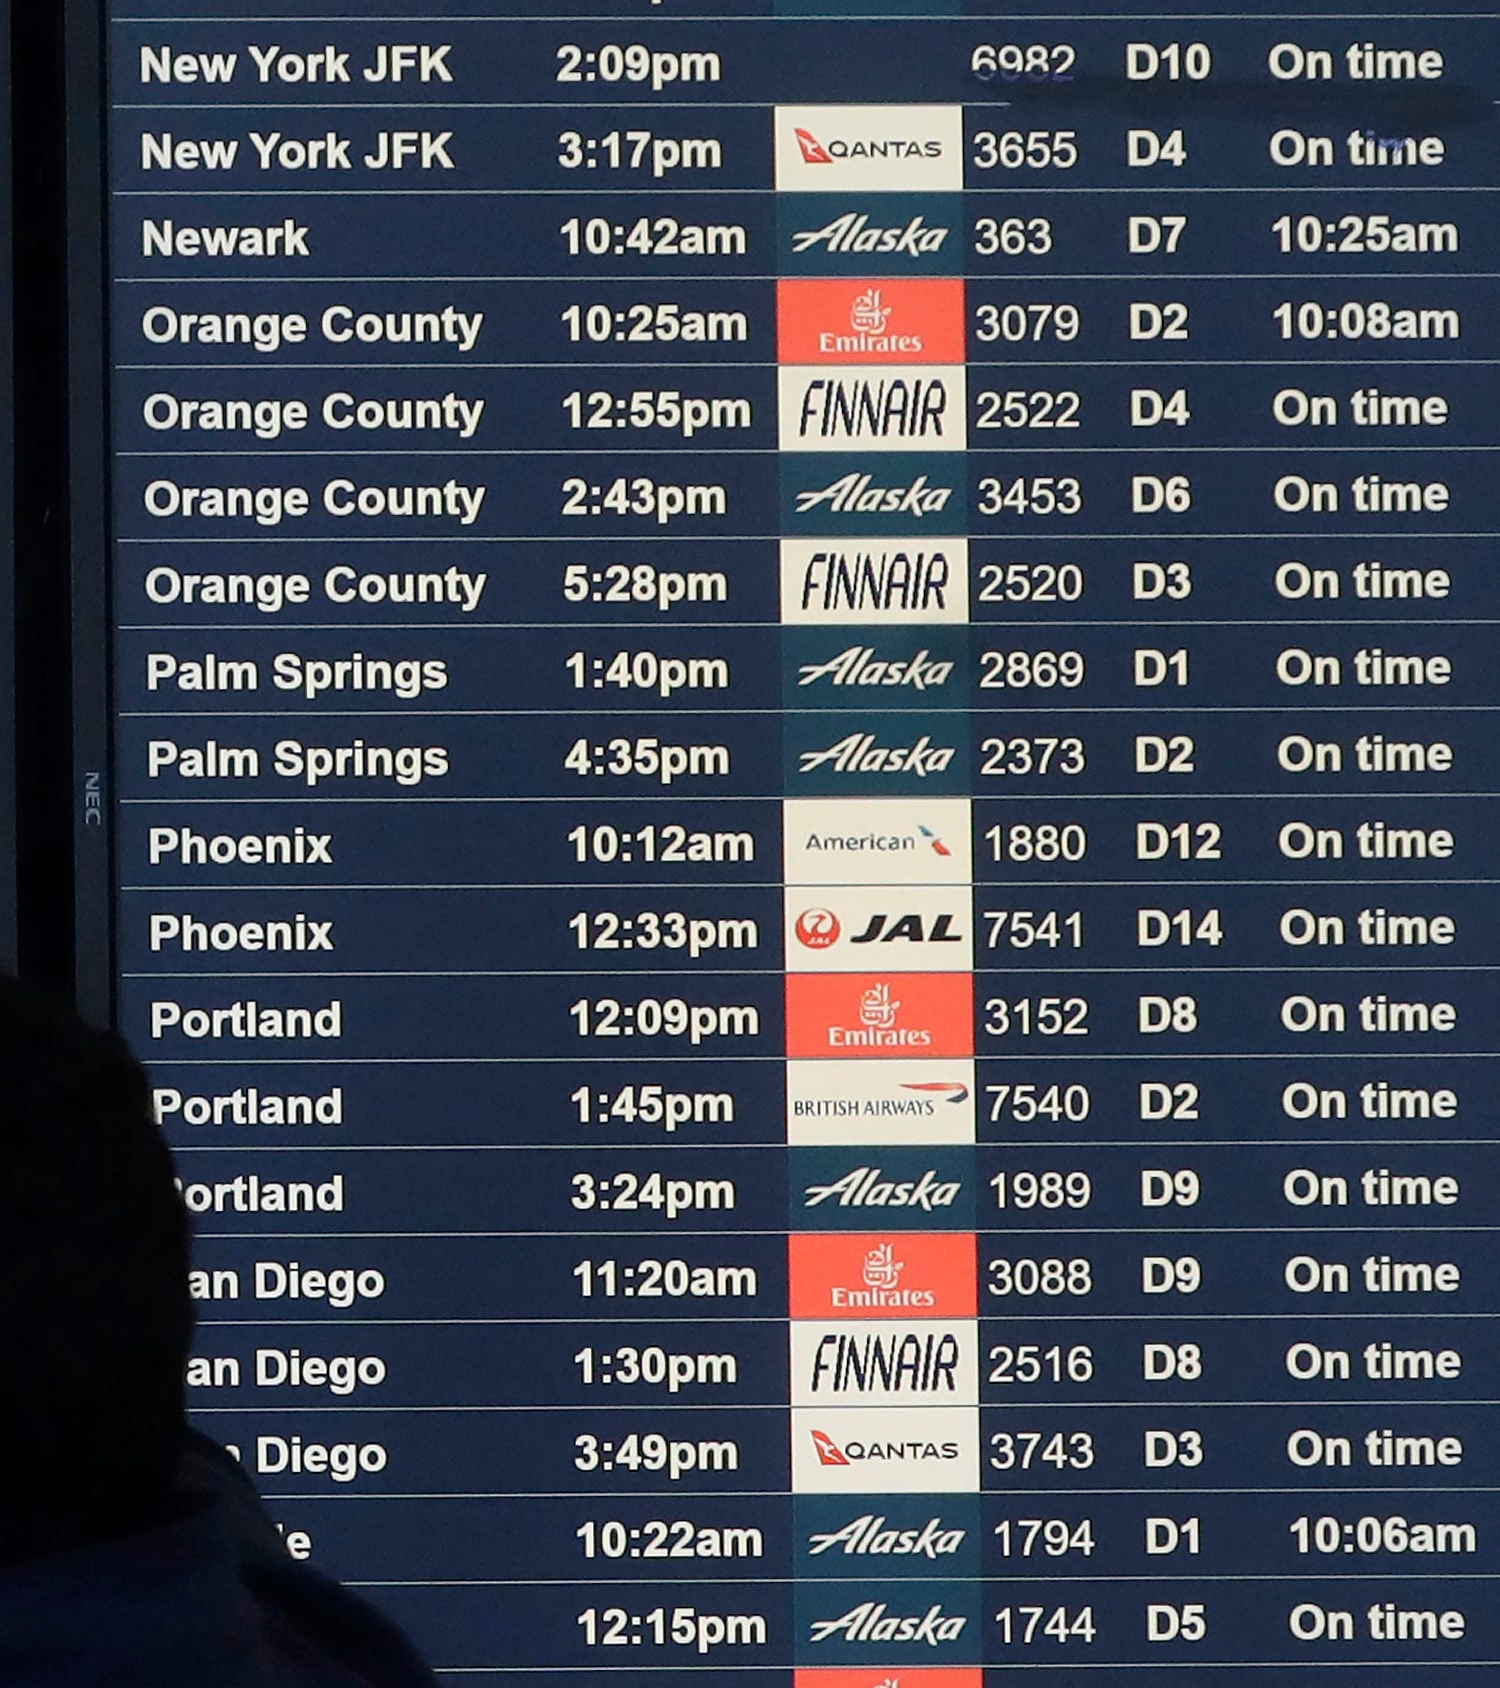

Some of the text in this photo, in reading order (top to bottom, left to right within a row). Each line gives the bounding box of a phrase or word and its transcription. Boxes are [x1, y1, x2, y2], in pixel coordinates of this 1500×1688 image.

[140, 45, 453, 83] New York JFK
[556, 44, 720, 91] 2:09pm
[971, 44, 1076, 81] 6982
[1126, 43, 1211, 80] D10
[1268, 42, 1443, 80] On time
[142, 131, 455, 170] New York JFK
[558, 131, 721, 178] 3:17pm
[829, 140, 942, 158] QANTAS
[143, 219, 310, 257] Newark
[560, 217, 746, 255] 10:42am
[792, 212, 948, 257] Alaska
[975, 218, 1052, 255] 363
[1272, 215, 1458, 253] 10:25am
[561, 304, 747, 342] 10:25am
[1130, 302, 1188, 340] D2
[1273, 301, 1459, 339] 10:08am
[819, 332, 922, 352] Emirates
[143, 392, 485, 439] Orange County
[800, 379, 947, 437] FINNAIR
[976, 391, 1080, 428] 2522
[561, 478, 726, 524] 2:43pm
[795, 472, 952, 518] Alaska
[1132, 475, 1191, 513] D6
[145, 566, 487, 613] Orange County
[802, 552, 949, 610] FINNAIR
[978, 564, 1083, 601] 2520
[147, 652, 448, 699] Palm Springs
[566, 651, 728, 698] 1:40pm
[798, 646, 955, 690] Alaska
[1134, 649, 1188, 686] D1
[148, 739, 449, 786] Palm Springs
[799, 733, 955, 777] Alaska
[980, 737, 1085, 775] 2373
[85, 772, 101, 825] NEC
[149, 826, 333, 864] Phoenix
[568, 825, 754, 862] 10:12am
[805, 833, 915, 851] American
[1278, 821, 1454, 859] On time
[150, 913, 334, 951] Phoenix
[850, 914, 962, 944] JAL
[983, 911, 1081, 948] 7541
[151, 1000, 341, 1038] Portland
[570, 998, 759, 1045] 12:09pm
[1139, 996, 1197, 1033] D8
[828, 1027, 931, 1047] Emirates
[152, 1087, 342, 1125] Portland
[794, 1100, 934, 1116] BRITISH AIRWAYS
[985, 1084, 1090, 1122] 7540
[174, 1174, 343, 1212] ortland
[571, 1172, 734, 1219] 3:24pm
[804, 1167, 962, 1212] Alaska
[1141, 1169, 1200, 1206] D9
[188, 1262, 385, 1308] an Diego
[988, 1258, 1092, 1296] 3088
[831, 1287, 936, 1308] Emirates
[811, 1334, 959, 1392] FINNAIR
[1143, 1343, 1202, 1380] D8
[257, 1436, 387, 1482] Diego
[574, 1434, 738, 1480] 3:49pm
[845, 1442, 959, 1459] QANTAS
[990, 1432, 1094, 1470] 3743
[808, 1515, 966, 1559] Alaska
[1146, 1517, 1199, 1554] D1
[1289, 1516, 1476, 1553] 10:06am
[577, 1607, 766, 1654] 12:15pm
[810, 1603, 967, 1646] Alaska
[995, 1606, 1097, 1644] 1744
